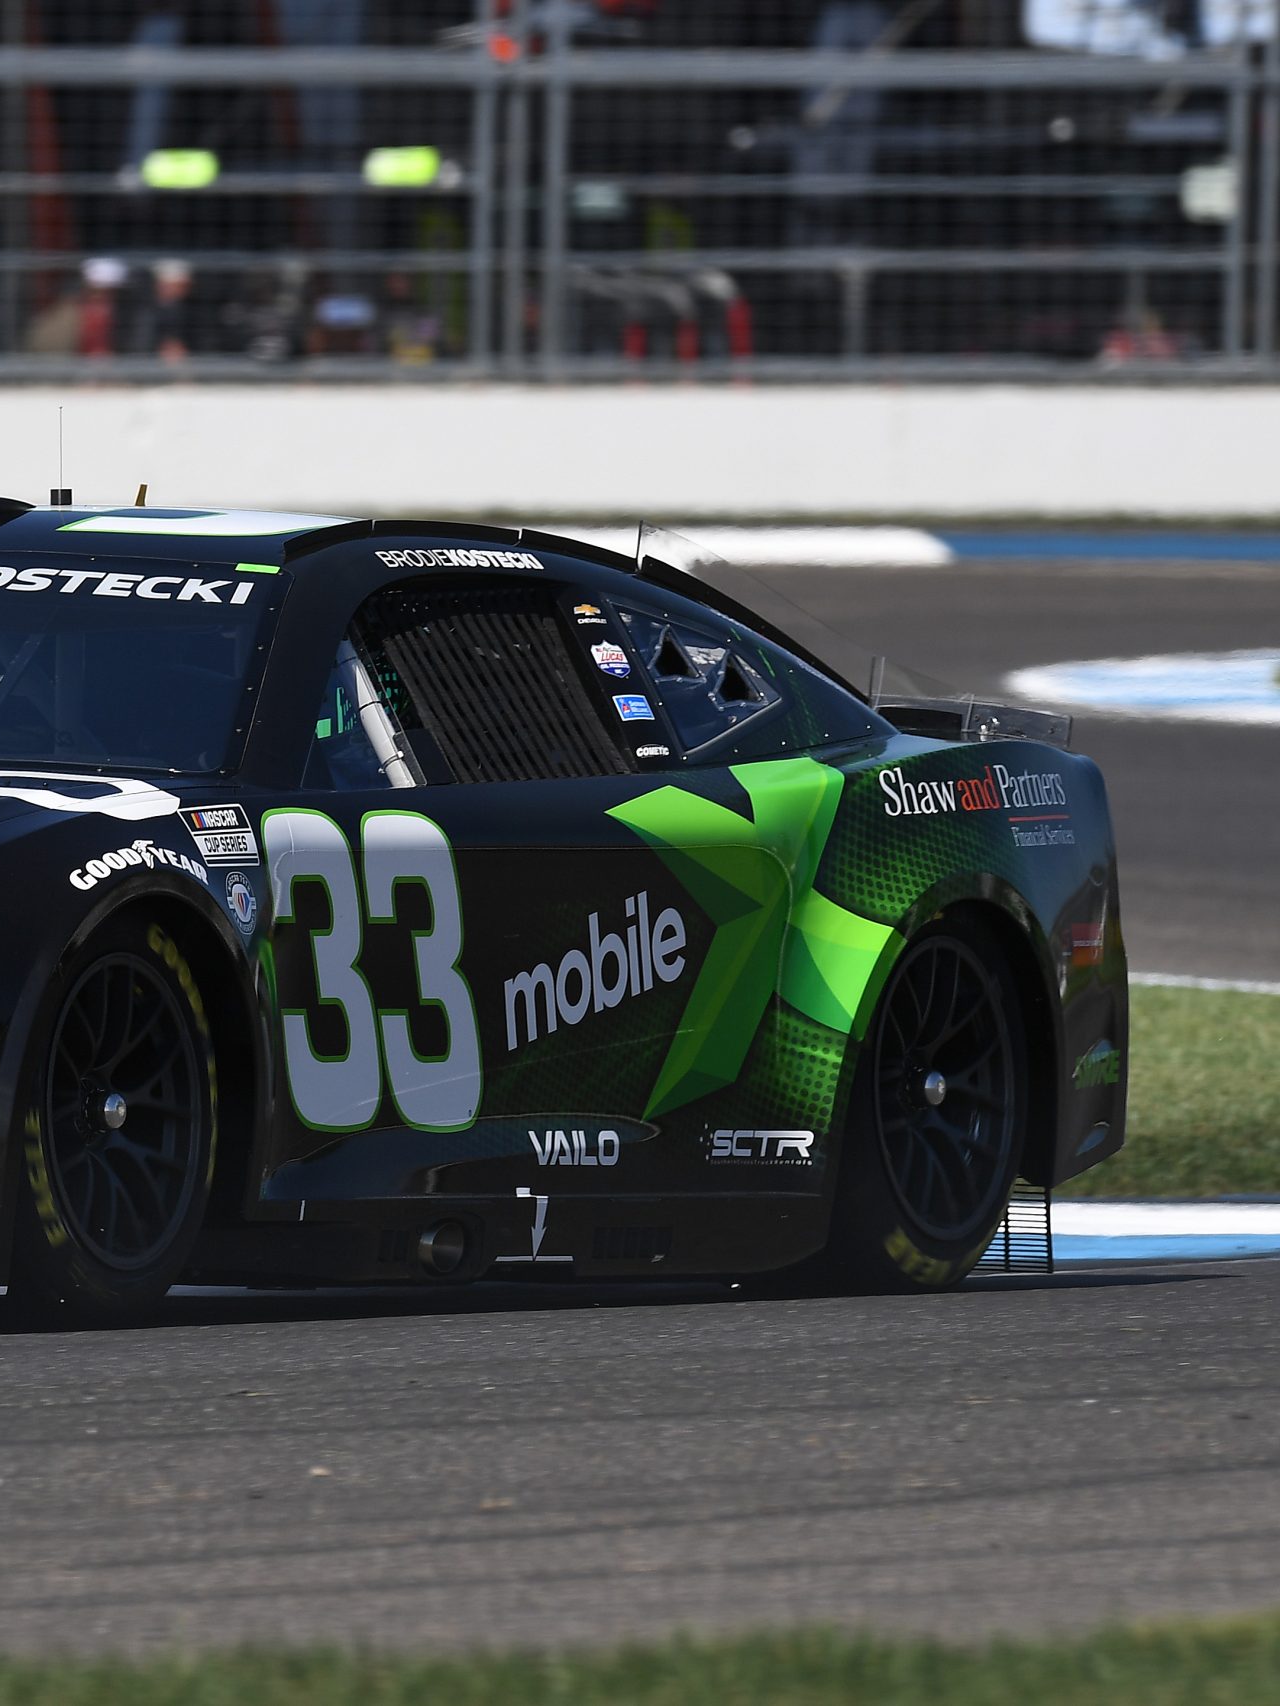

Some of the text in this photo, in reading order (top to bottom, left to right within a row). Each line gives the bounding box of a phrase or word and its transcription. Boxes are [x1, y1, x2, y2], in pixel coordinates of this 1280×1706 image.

[600, 652, 625, 662] LUCAS
[636, 747, 670, 758] COMETIC
[878, 764, 1067, 817] Shaw and Partners
[202, 809, 239, 829] NASCAR
[204, 835, 248, 853] CUP SERIES
[261, 807, 483, 1134] 33
[504, 890, 687, 1052] mobile
[527, 1129, 621, 1166] VAILO
[711, 1129, 815, 1158] SCTR
